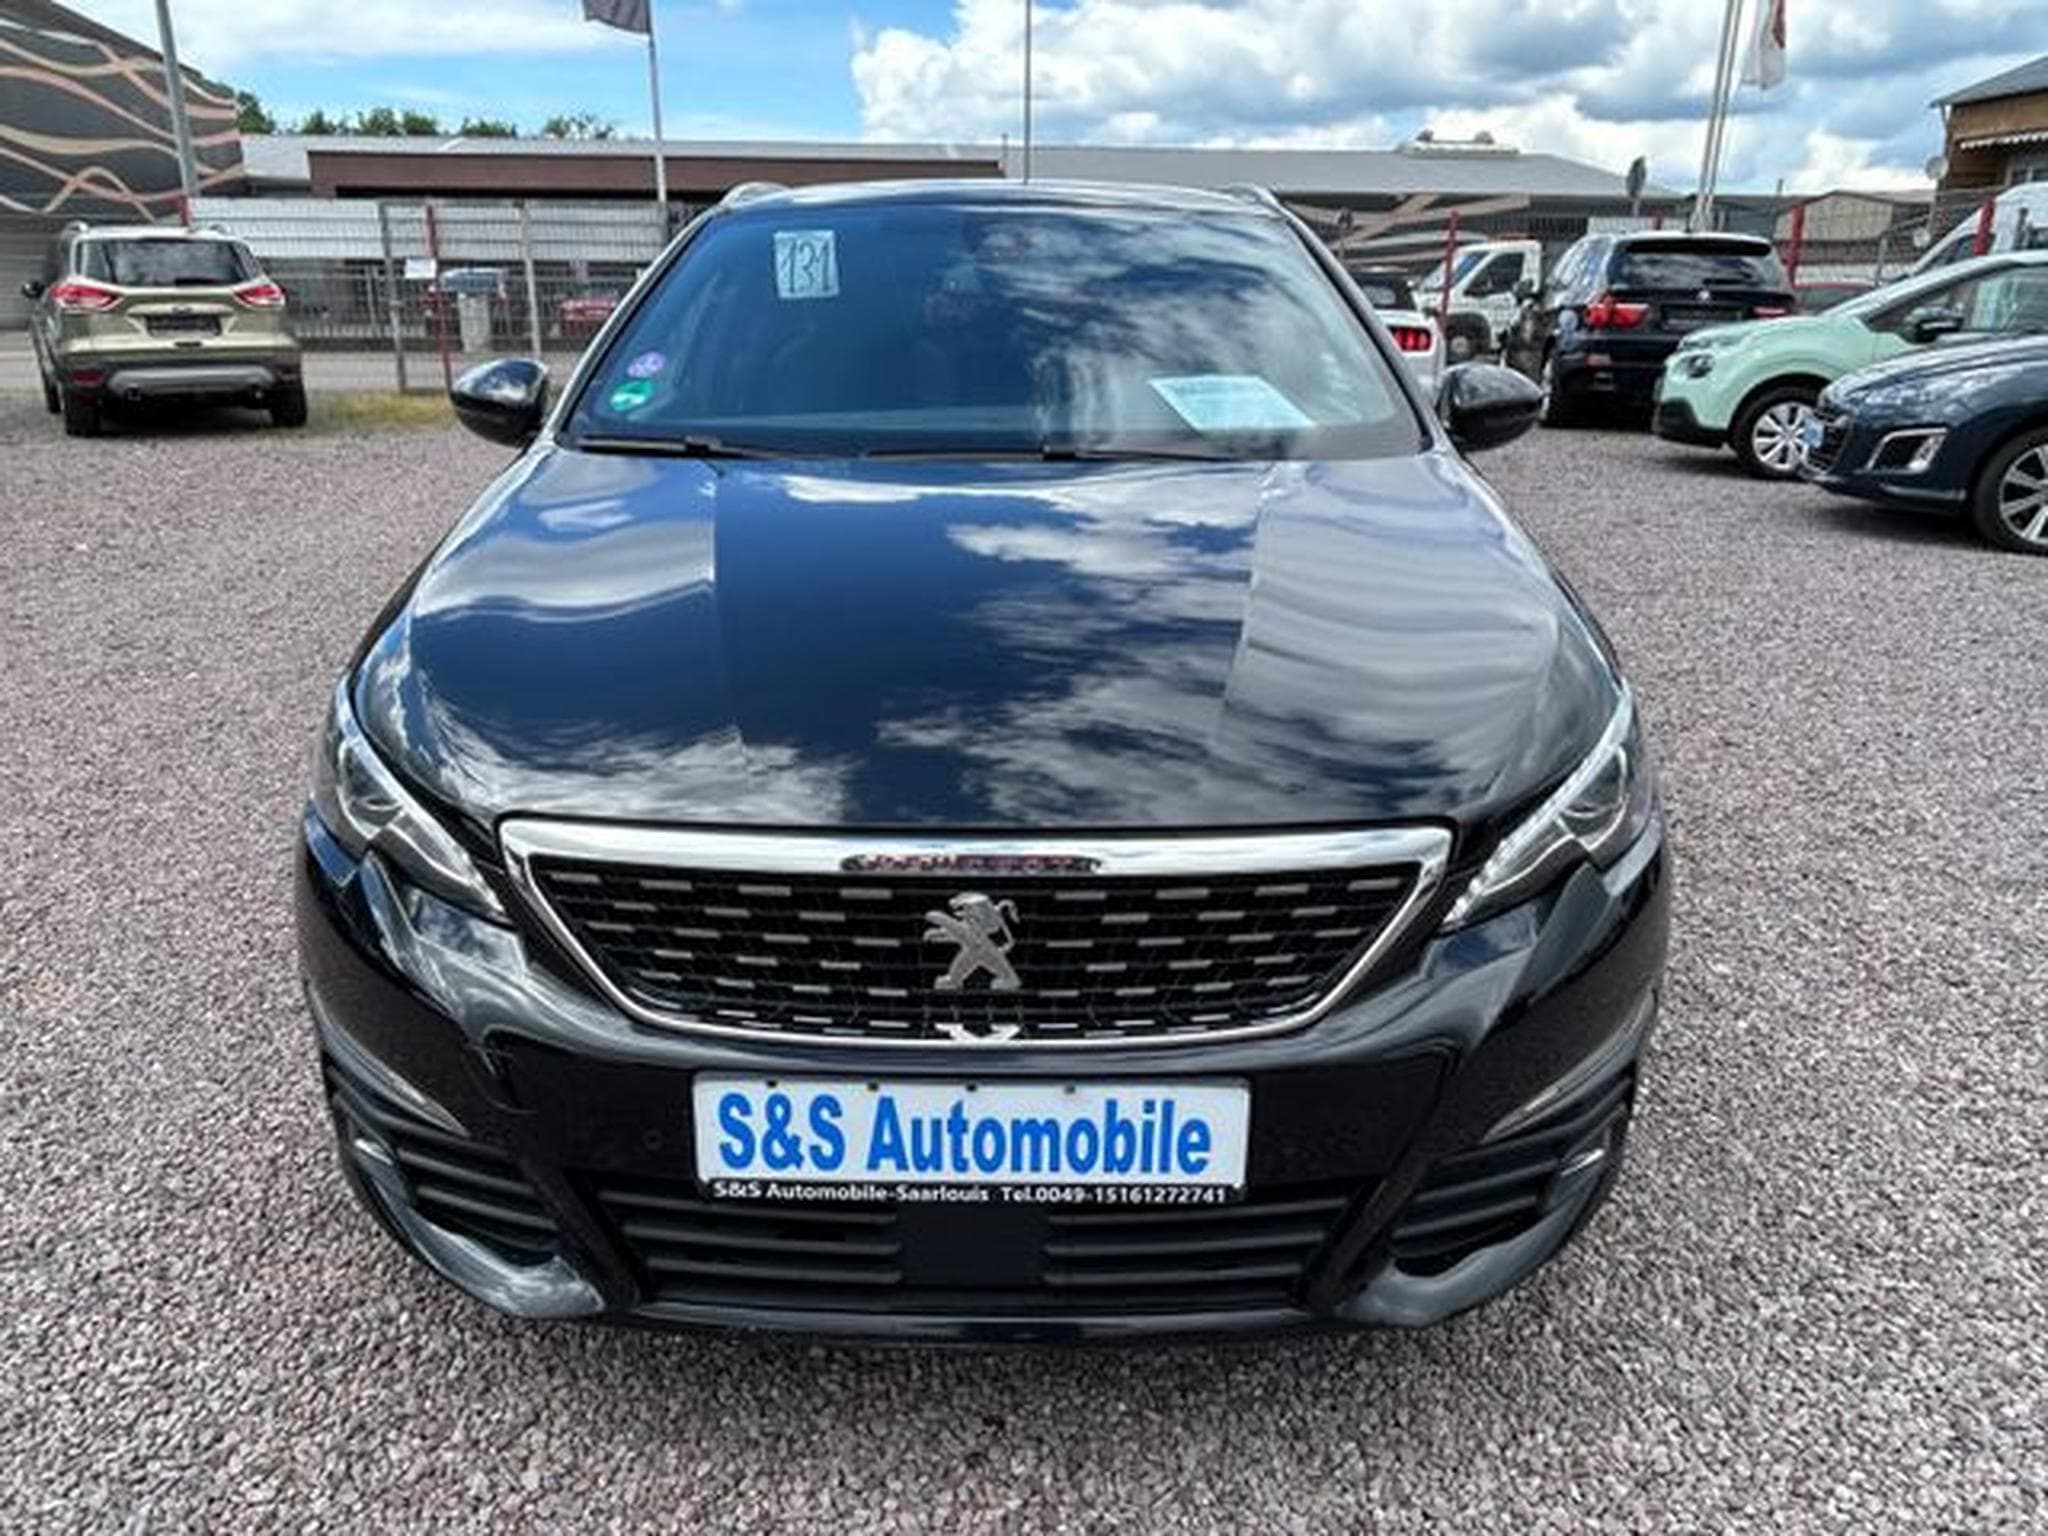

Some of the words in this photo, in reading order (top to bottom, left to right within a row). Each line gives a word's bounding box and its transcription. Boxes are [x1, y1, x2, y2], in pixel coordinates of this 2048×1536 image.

[717, 1092, 847, 1172] S&S
[866, 1095, 1212, 1175] Automobile
[713, 1181, 762, 1199] S&S
[765, 1183, 990, 1203] Automobile-Saarlouis
